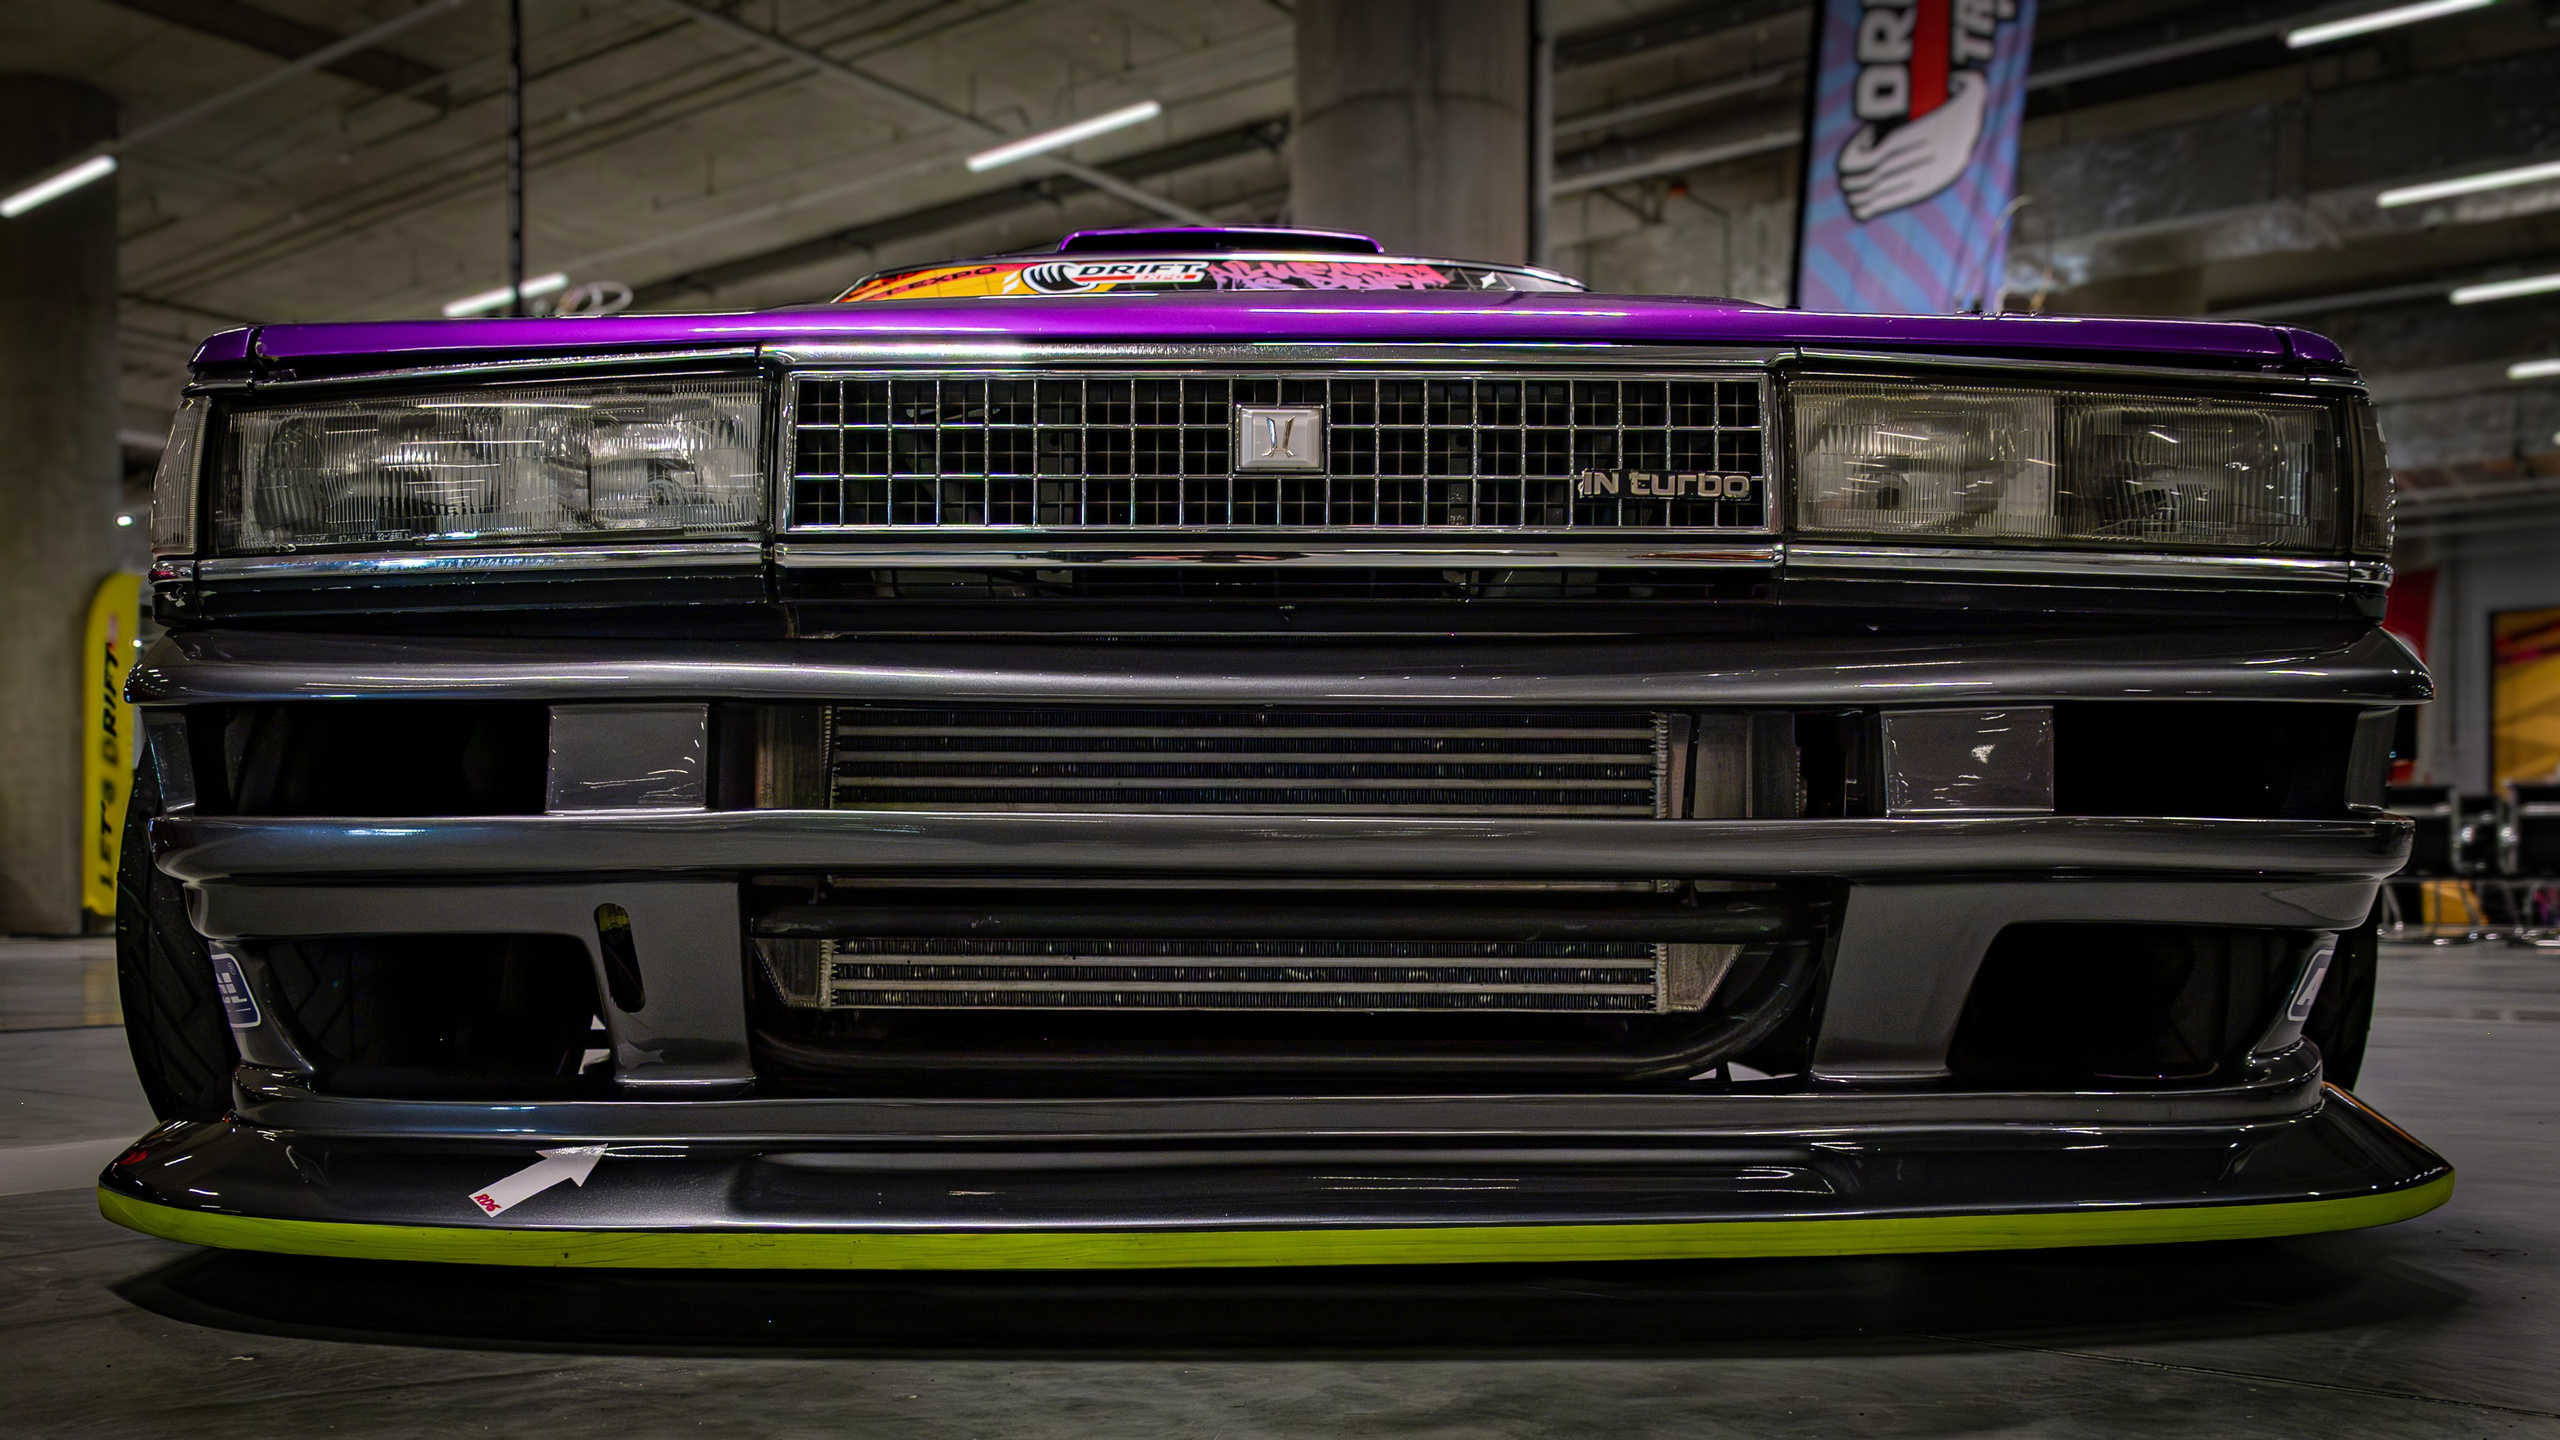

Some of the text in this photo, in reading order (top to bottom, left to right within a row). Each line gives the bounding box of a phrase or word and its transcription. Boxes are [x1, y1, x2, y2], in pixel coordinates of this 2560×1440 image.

[1856, 0, 1917, 119] DR
[908, 266, 997, 290] EXPO
[1079, 263, 1202, 276] DRIFT
[1583, 469, 1750, 498] IN turbo
[102, 644, 119, 768] DRIFT
